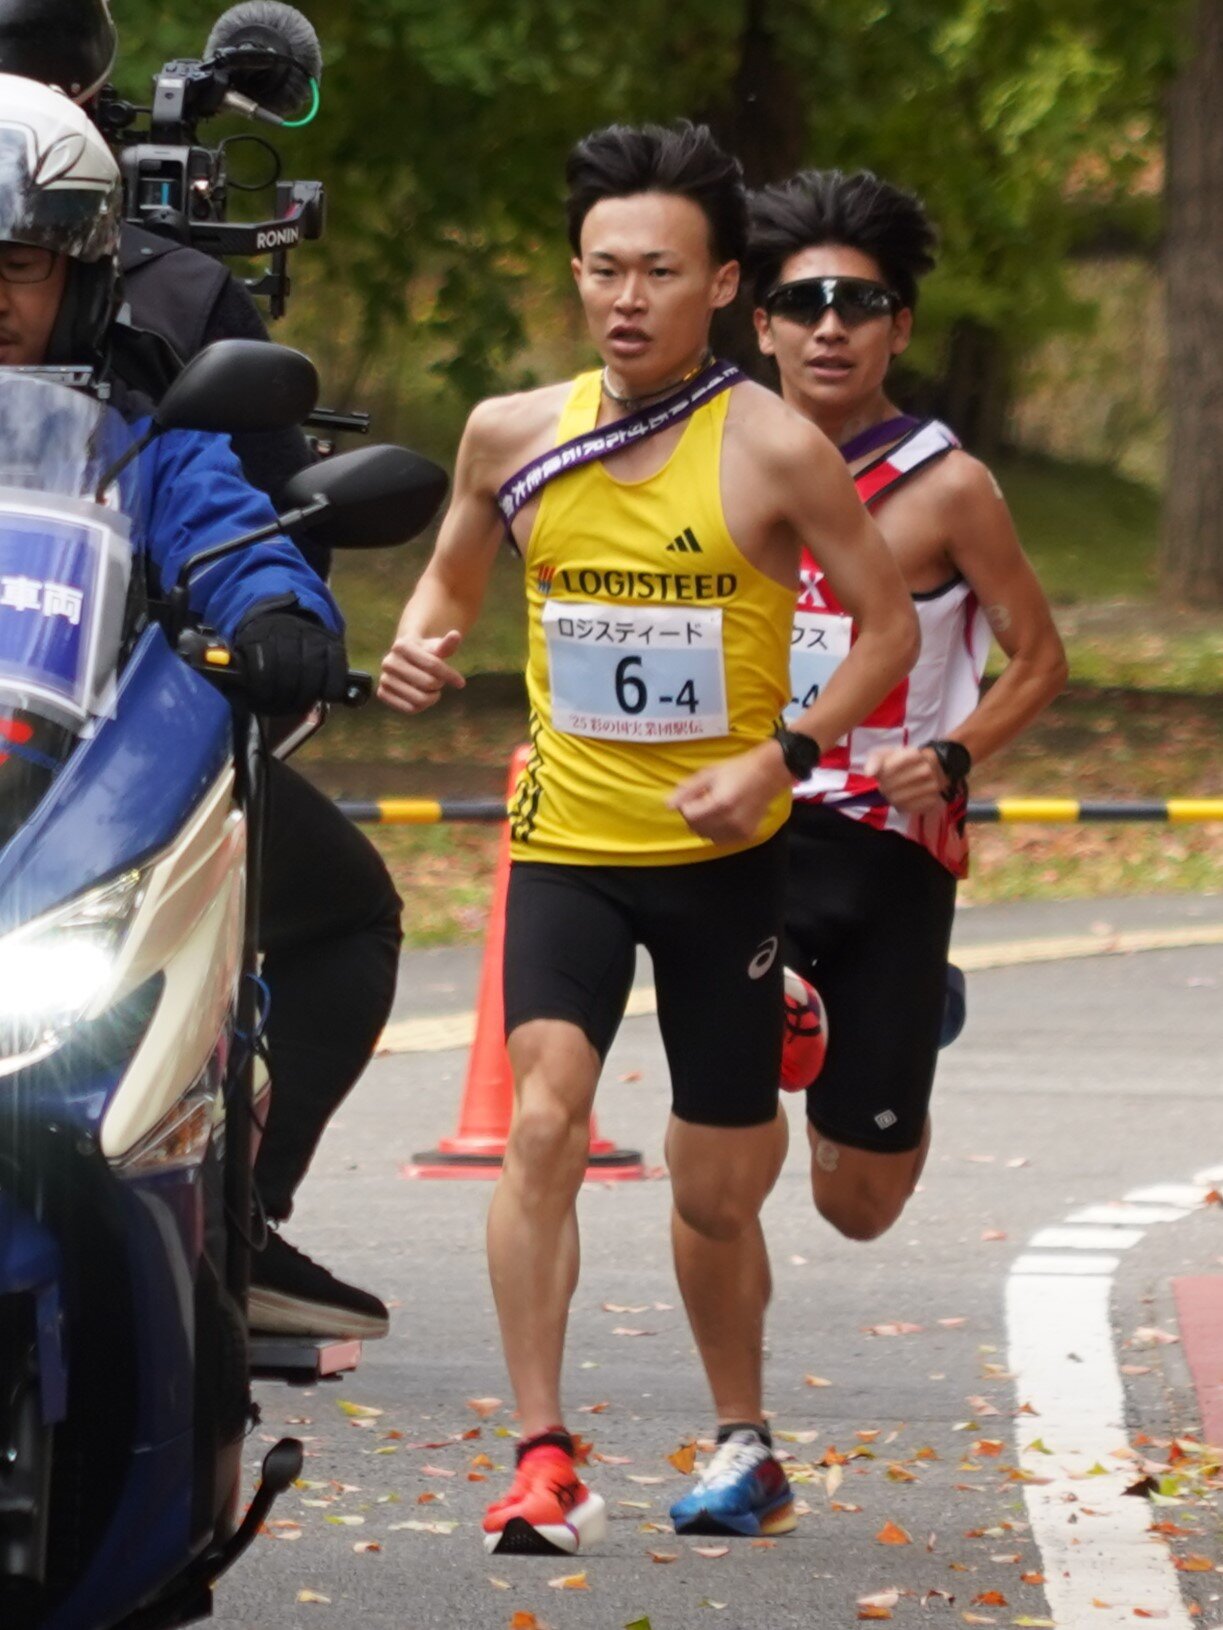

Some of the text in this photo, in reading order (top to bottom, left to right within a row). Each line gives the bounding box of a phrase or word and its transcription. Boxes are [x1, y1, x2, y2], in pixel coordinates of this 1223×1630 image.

[257, 226, 299, 249] RONIN
[561, 569, 737, 600] LOGISTEED
[0, 576, 84, 625] 車両
[558, 617, 703, 645] ロジスティード
